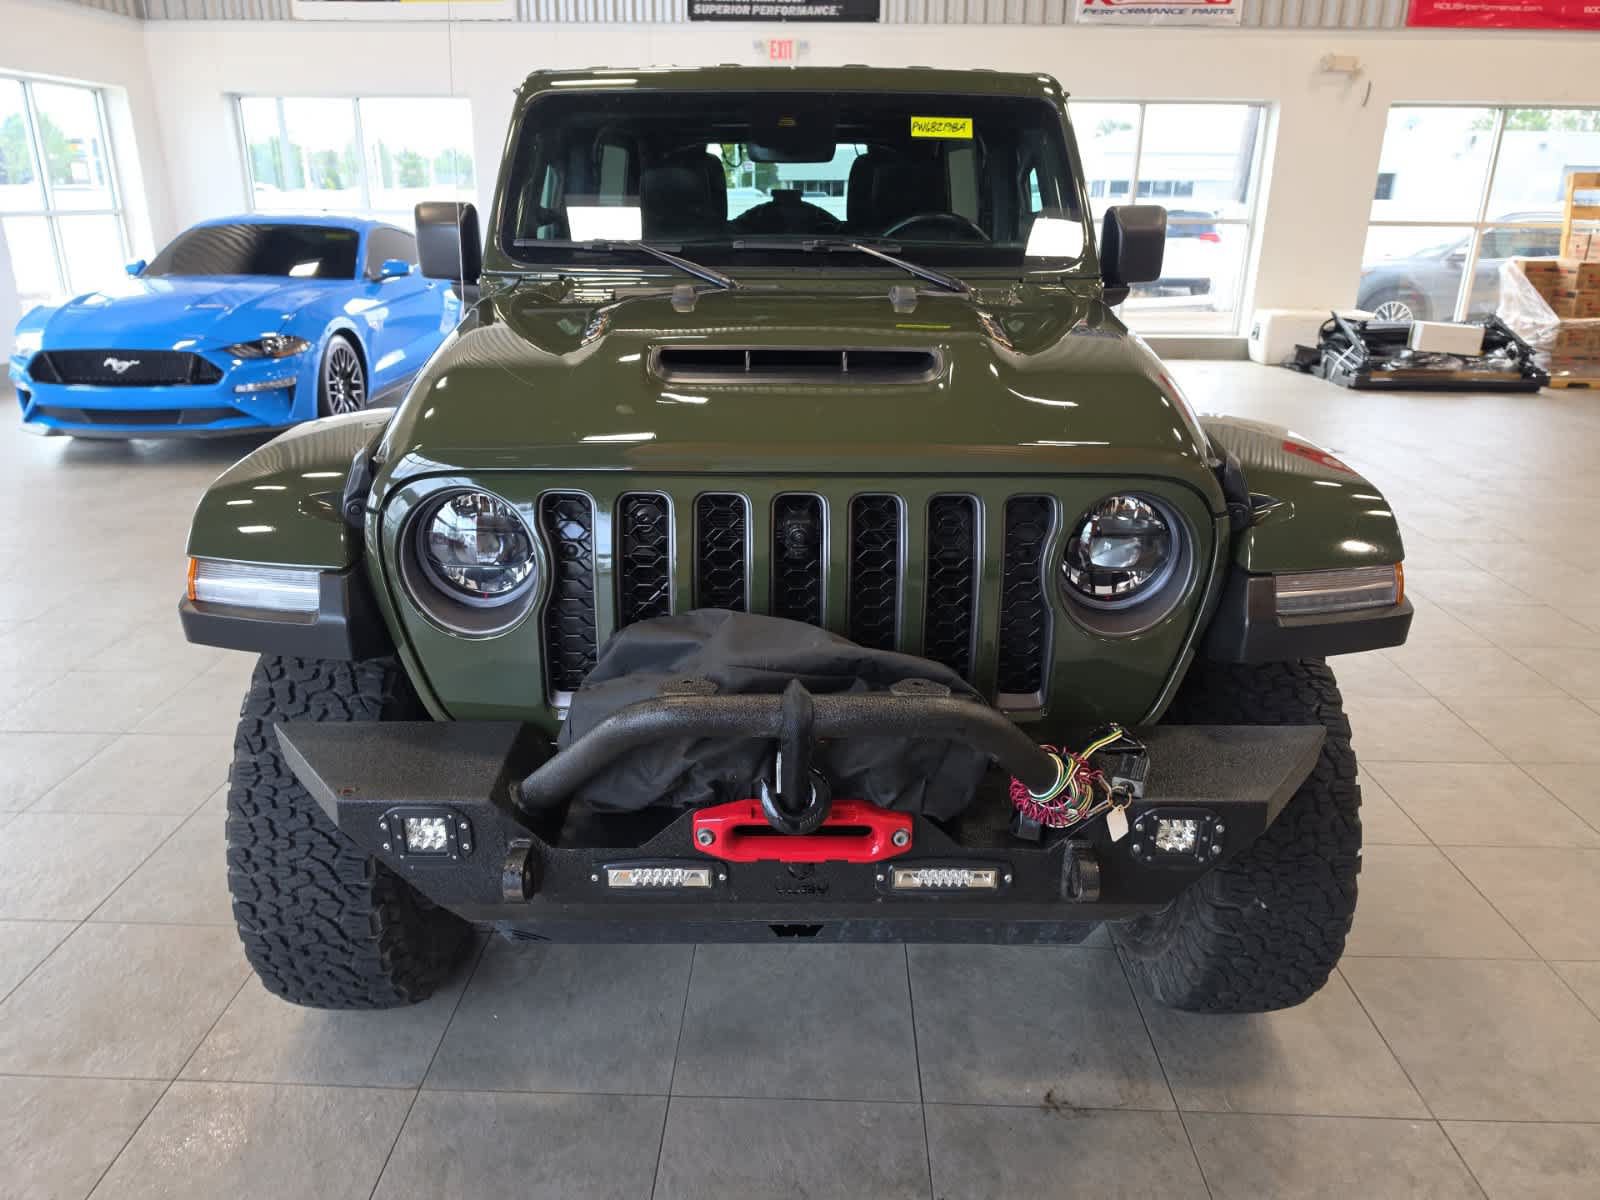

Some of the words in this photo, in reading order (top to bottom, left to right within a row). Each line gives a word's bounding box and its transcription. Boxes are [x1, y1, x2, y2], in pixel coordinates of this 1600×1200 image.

[693, 3, 750, 15] SUPERIOR
[1082, 7, 1186, 15] PERFORMANCE
[1191, 7, 1236, 15] PARTS
[769, 39, 794, 60] EXIT
